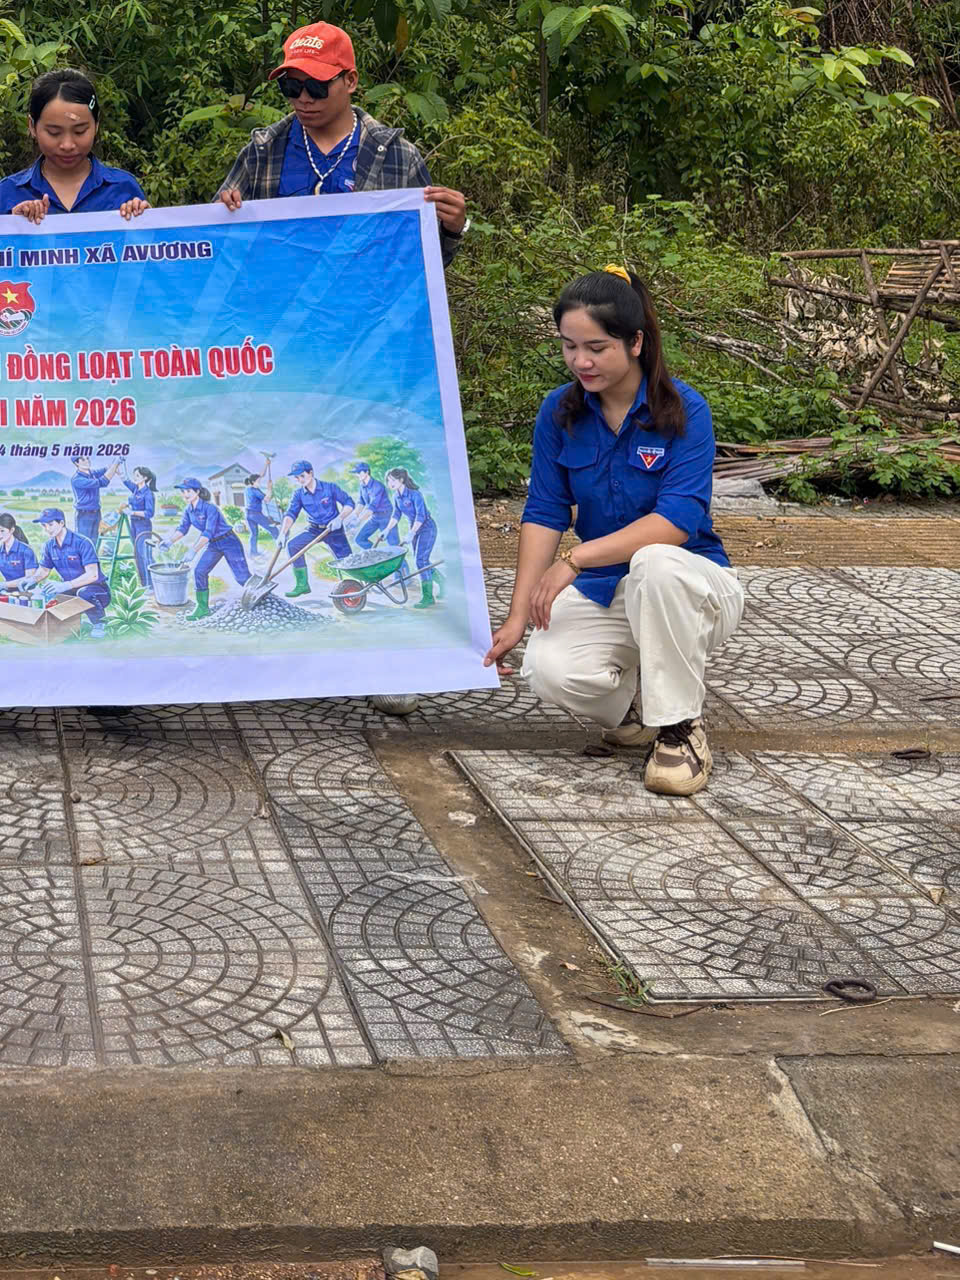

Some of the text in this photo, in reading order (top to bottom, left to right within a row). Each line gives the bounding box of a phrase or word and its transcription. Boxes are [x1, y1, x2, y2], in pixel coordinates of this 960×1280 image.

[19, 248, 80, 267] MINH
[85, 243, 117, 265] XÃ
[122, 240, 212, 263] AVƯƠNG
[7, 344, 71, 381] ĐỒNG
[78, 350, 134, 384] LOẠT
[140, 344, 201, 378] TOÀN
[208, 336, 275, 379] QUỐC
[15, 394, 67, 427] NĂM
[73, 397, 137, 427] 2026
[10, 442, 48, 458] tháng
[51, 443, 60, 457] 5
[63, 442, 91, 457] năm
[96, 443, 130, 457] 2026
